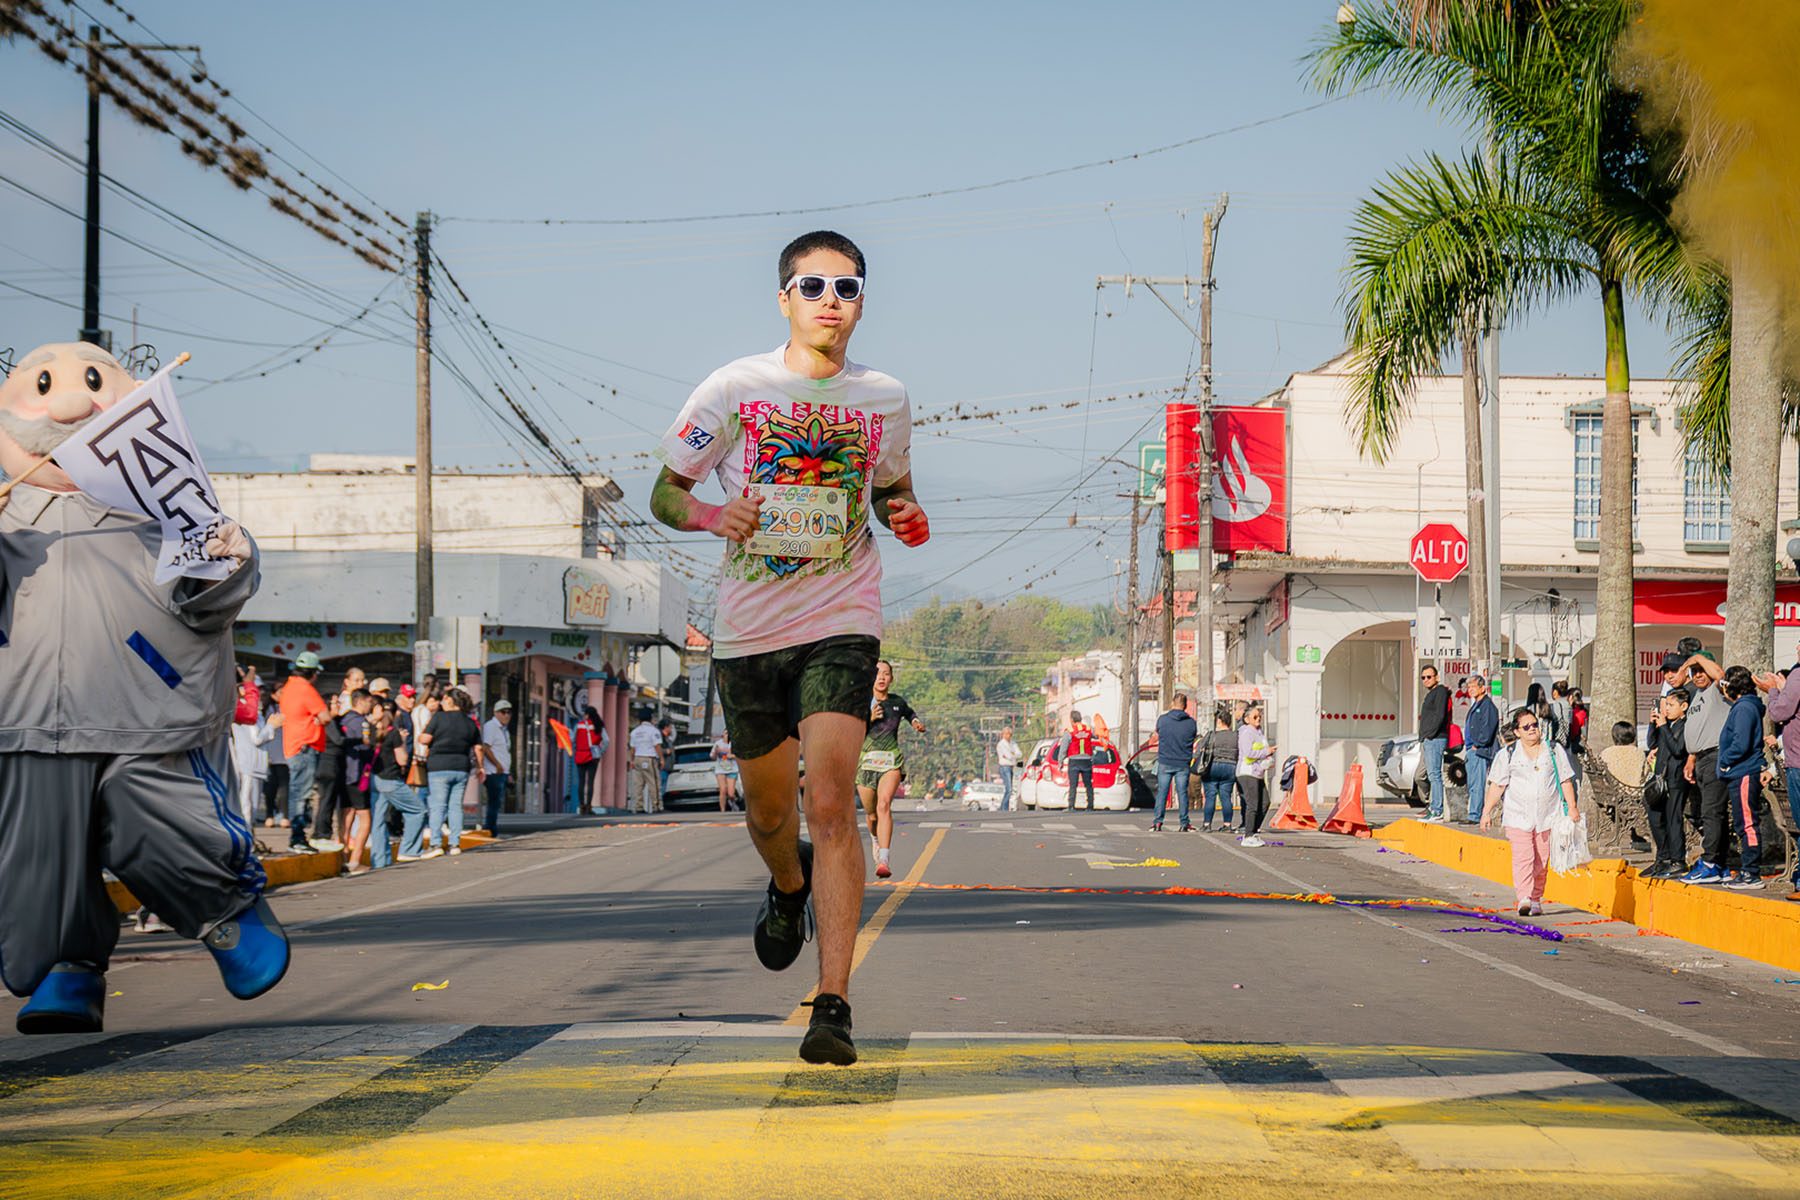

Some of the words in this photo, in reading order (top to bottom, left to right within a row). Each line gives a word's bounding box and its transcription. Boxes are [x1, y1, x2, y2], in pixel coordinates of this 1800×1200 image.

[764, 506, 828, 538] 290
[779, 540, 811, 556] 290
[1412, 540, 1466, 564] ALTO
[1639, 651, 1652, 666] TU
[1639, 669, 1652, 684] TU
